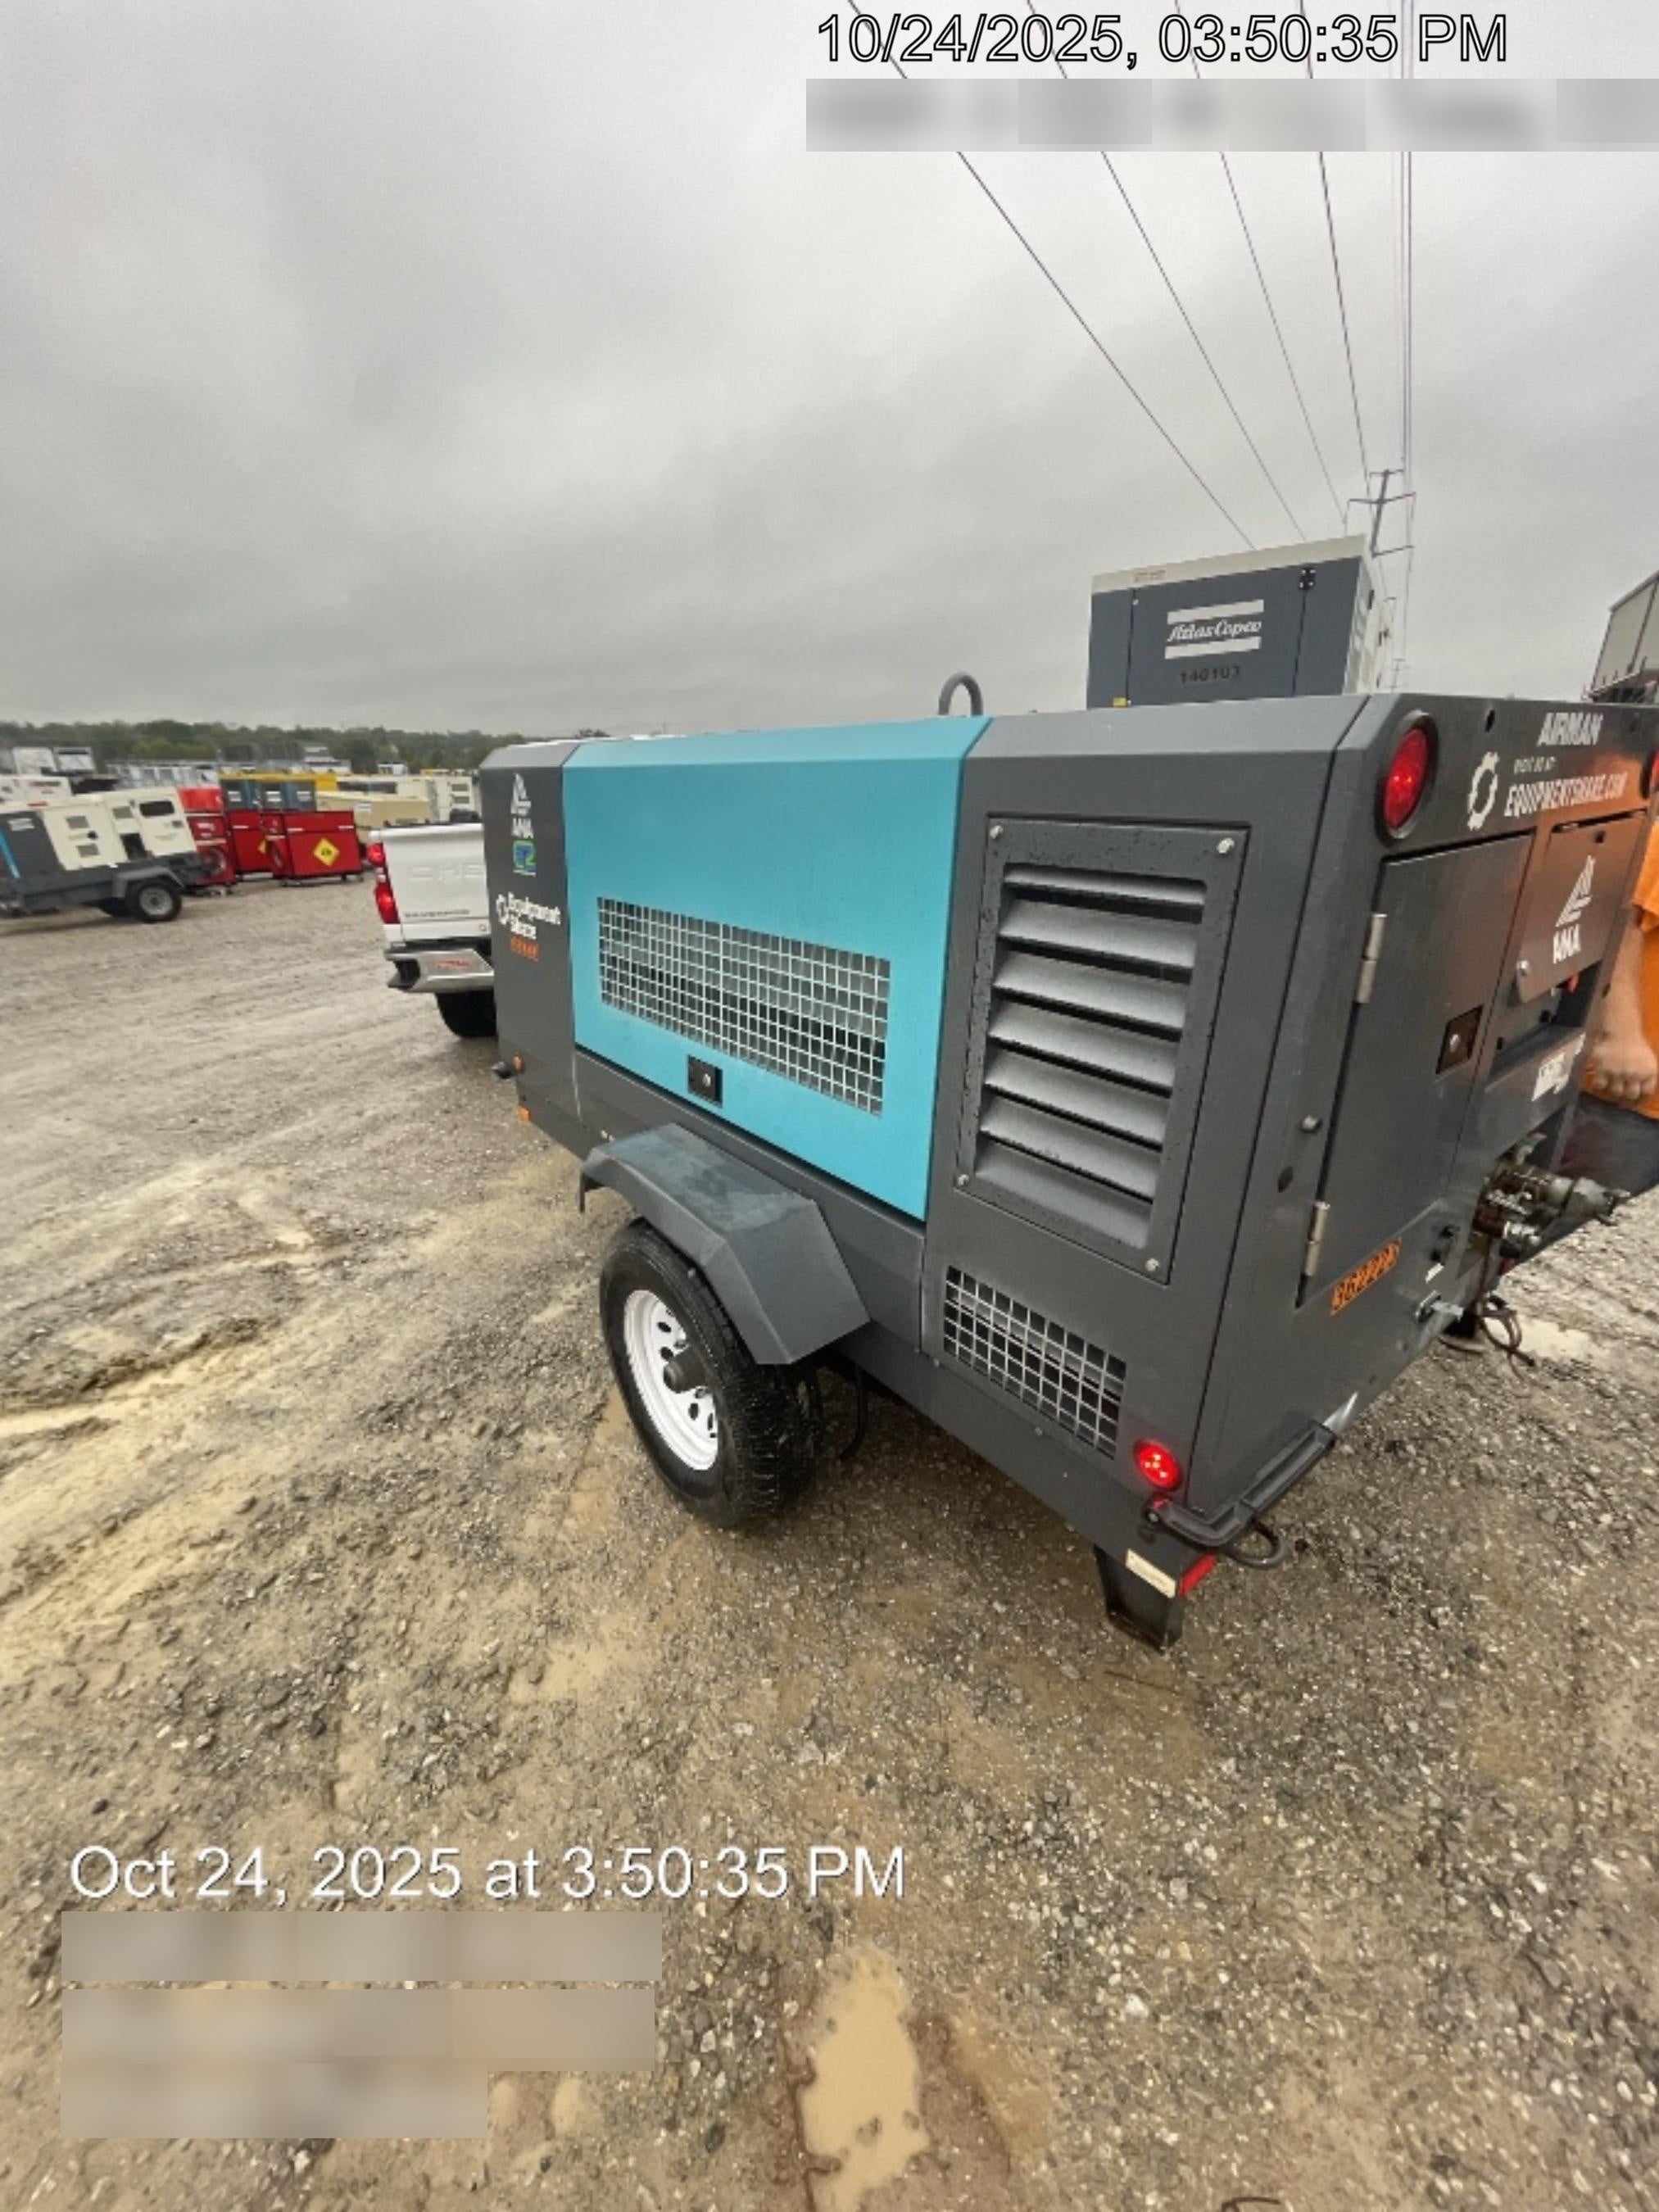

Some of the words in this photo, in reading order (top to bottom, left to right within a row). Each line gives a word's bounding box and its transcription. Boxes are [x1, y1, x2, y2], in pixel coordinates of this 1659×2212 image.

[1167, 623, 1213, 642] Atlas
[1213, 619, 1262, 638] Copco
[1537, 712, 1603, 746] AIRMAN
